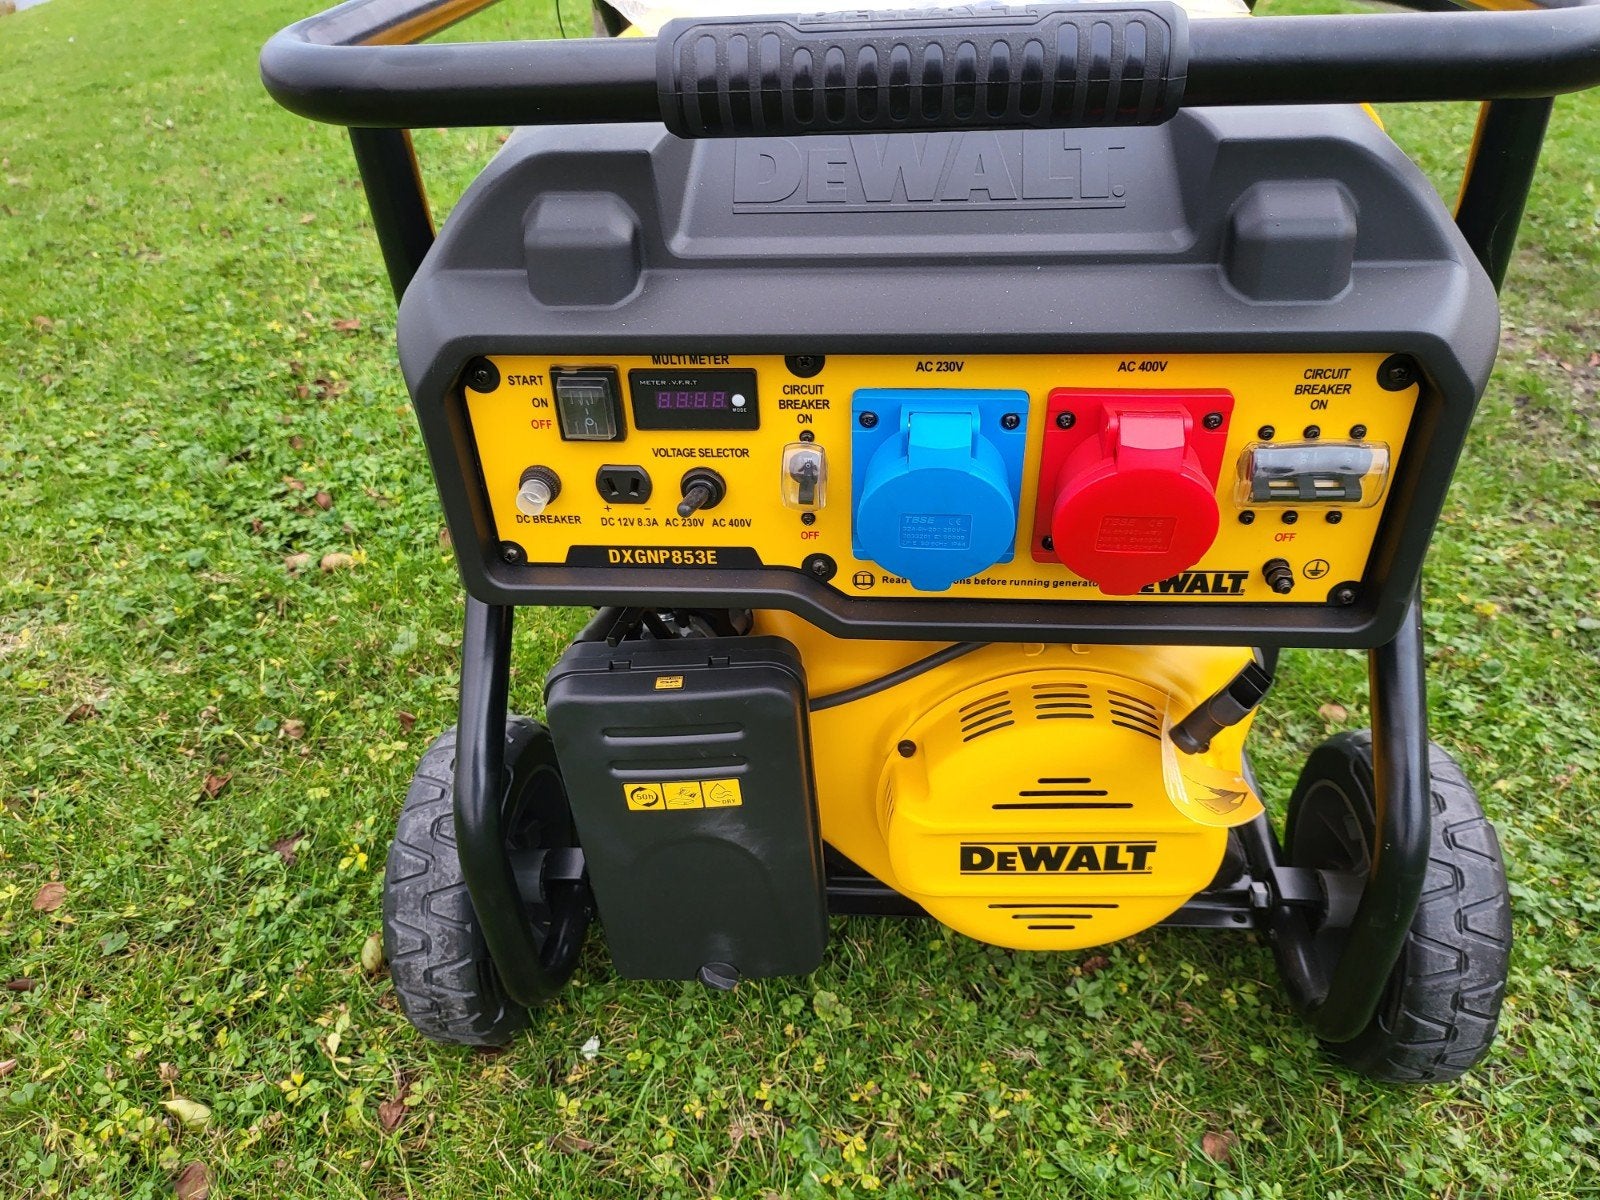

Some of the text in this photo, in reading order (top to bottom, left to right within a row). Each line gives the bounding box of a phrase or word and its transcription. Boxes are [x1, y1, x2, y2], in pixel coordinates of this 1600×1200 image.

[916, 361, 965, 372] AC 230V
[1118, 361, 1168, 372] AC 400V
[1304, 368, 1352, 380] CIRCUIT
[507, 375, 544, 386] START
[782, 384, 825, 395] CIRCUIT
[1294, 384, 1352, 395] BREAKER
[532, 397, 549, 408] ON
[778, 399, 830, 410] BREAKER
[1310, 399, 1329, 410] ON
[797, 413, 813, 424] ON
[531, 419, 552, 430] OFF
[651, 447, 750, 458] VOLTAGE SELECTOR
[516, 514, 582, 525] DC BREAKER
[601, 517, 659, 527] DC 12V 8.3A
[665, 518, 705, 528] AC 230V
[712, 518, 752, 528] AC 400V
[800, 531, 820, 540] OFF
[1274, 532, 1297, 542] OFF
[608, 549, 718, 565] DXGNP853E
[974, 576, 1007, 586] before
[1010, 578, 1050, 588] running
[1052, 579, 1098, 589] generato
[1140, 573, 1249, 593] EWALT
